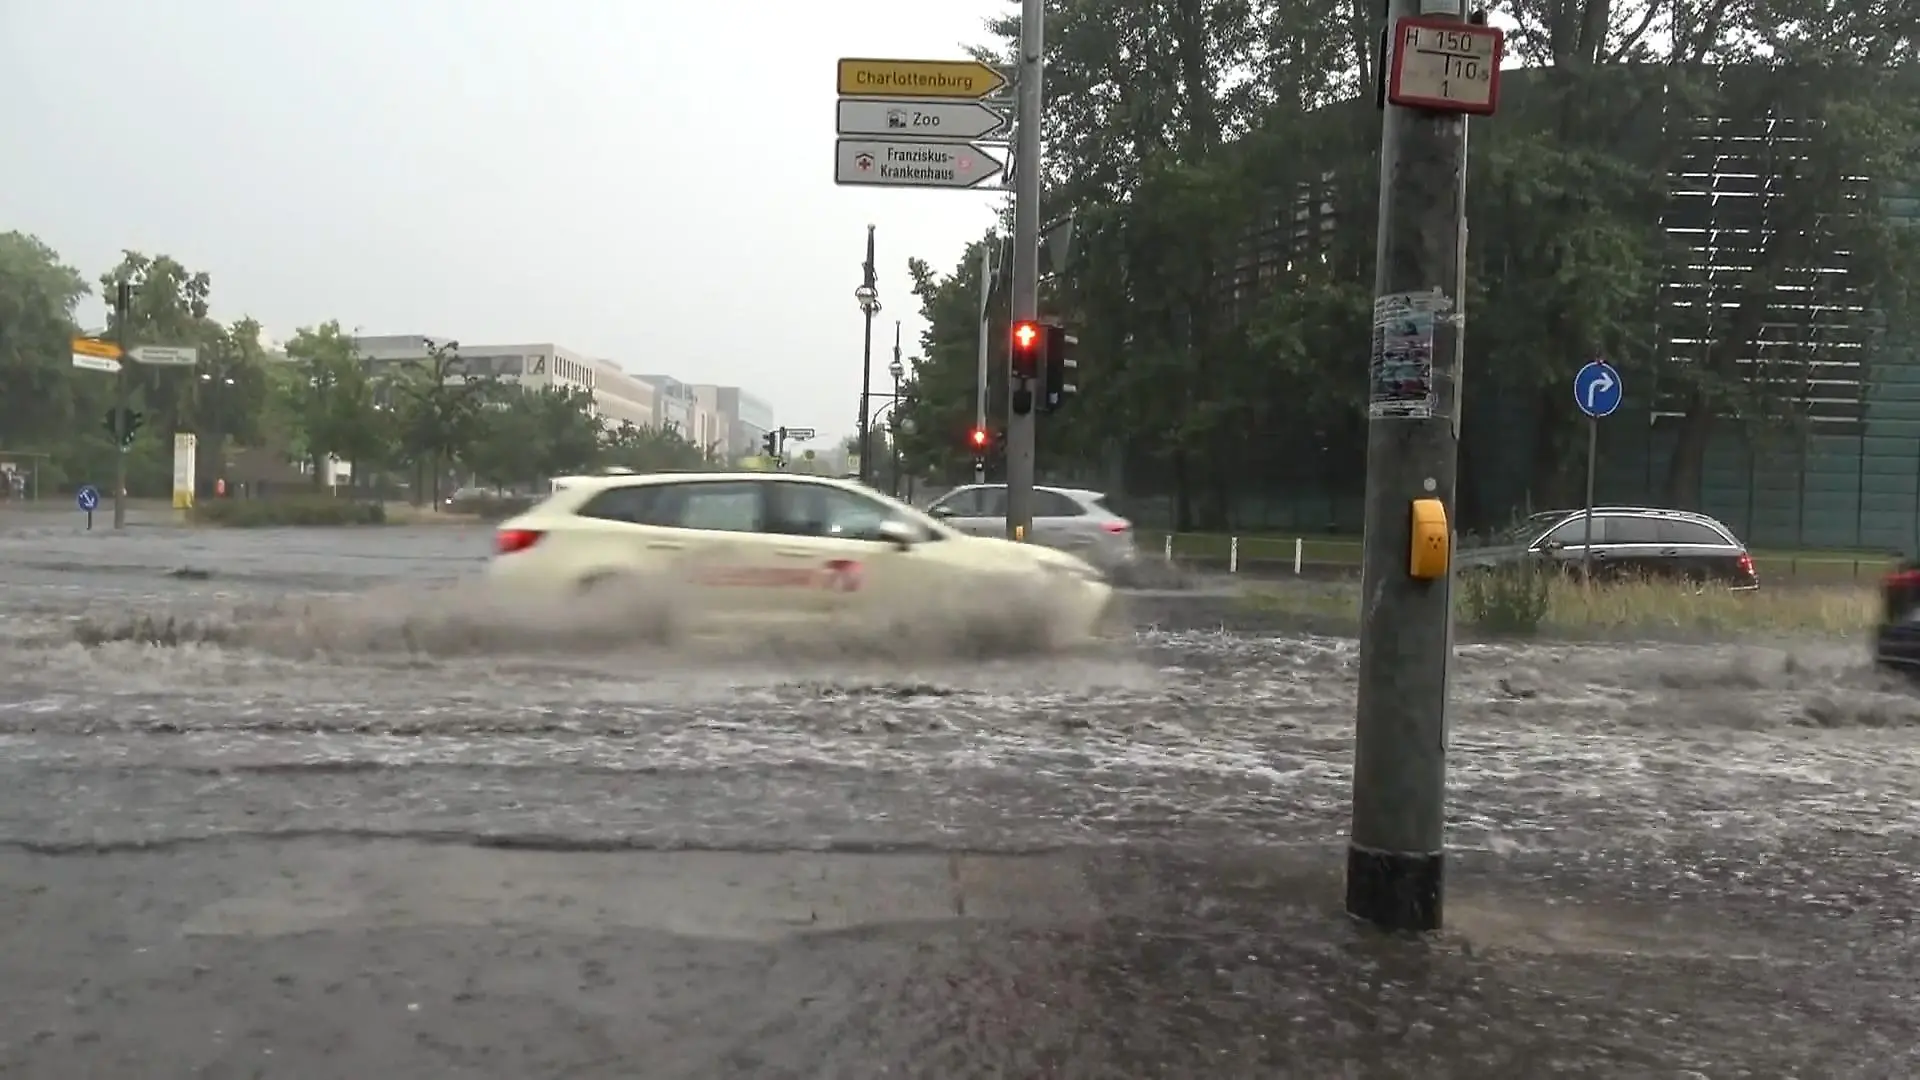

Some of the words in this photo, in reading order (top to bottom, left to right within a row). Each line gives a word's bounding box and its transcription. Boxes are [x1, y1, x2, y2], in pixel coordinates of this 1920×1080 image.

[1406, 28, 1419, 46] H
[1436, 31, 1472, 52] 150
[856, 70, 973, 90] Charlottenburg
[912, 111, 941, 127] Zoo
[887, 147, 955, 163] Franziskus-
[880, 164, 955, 180] Krankenhaus
